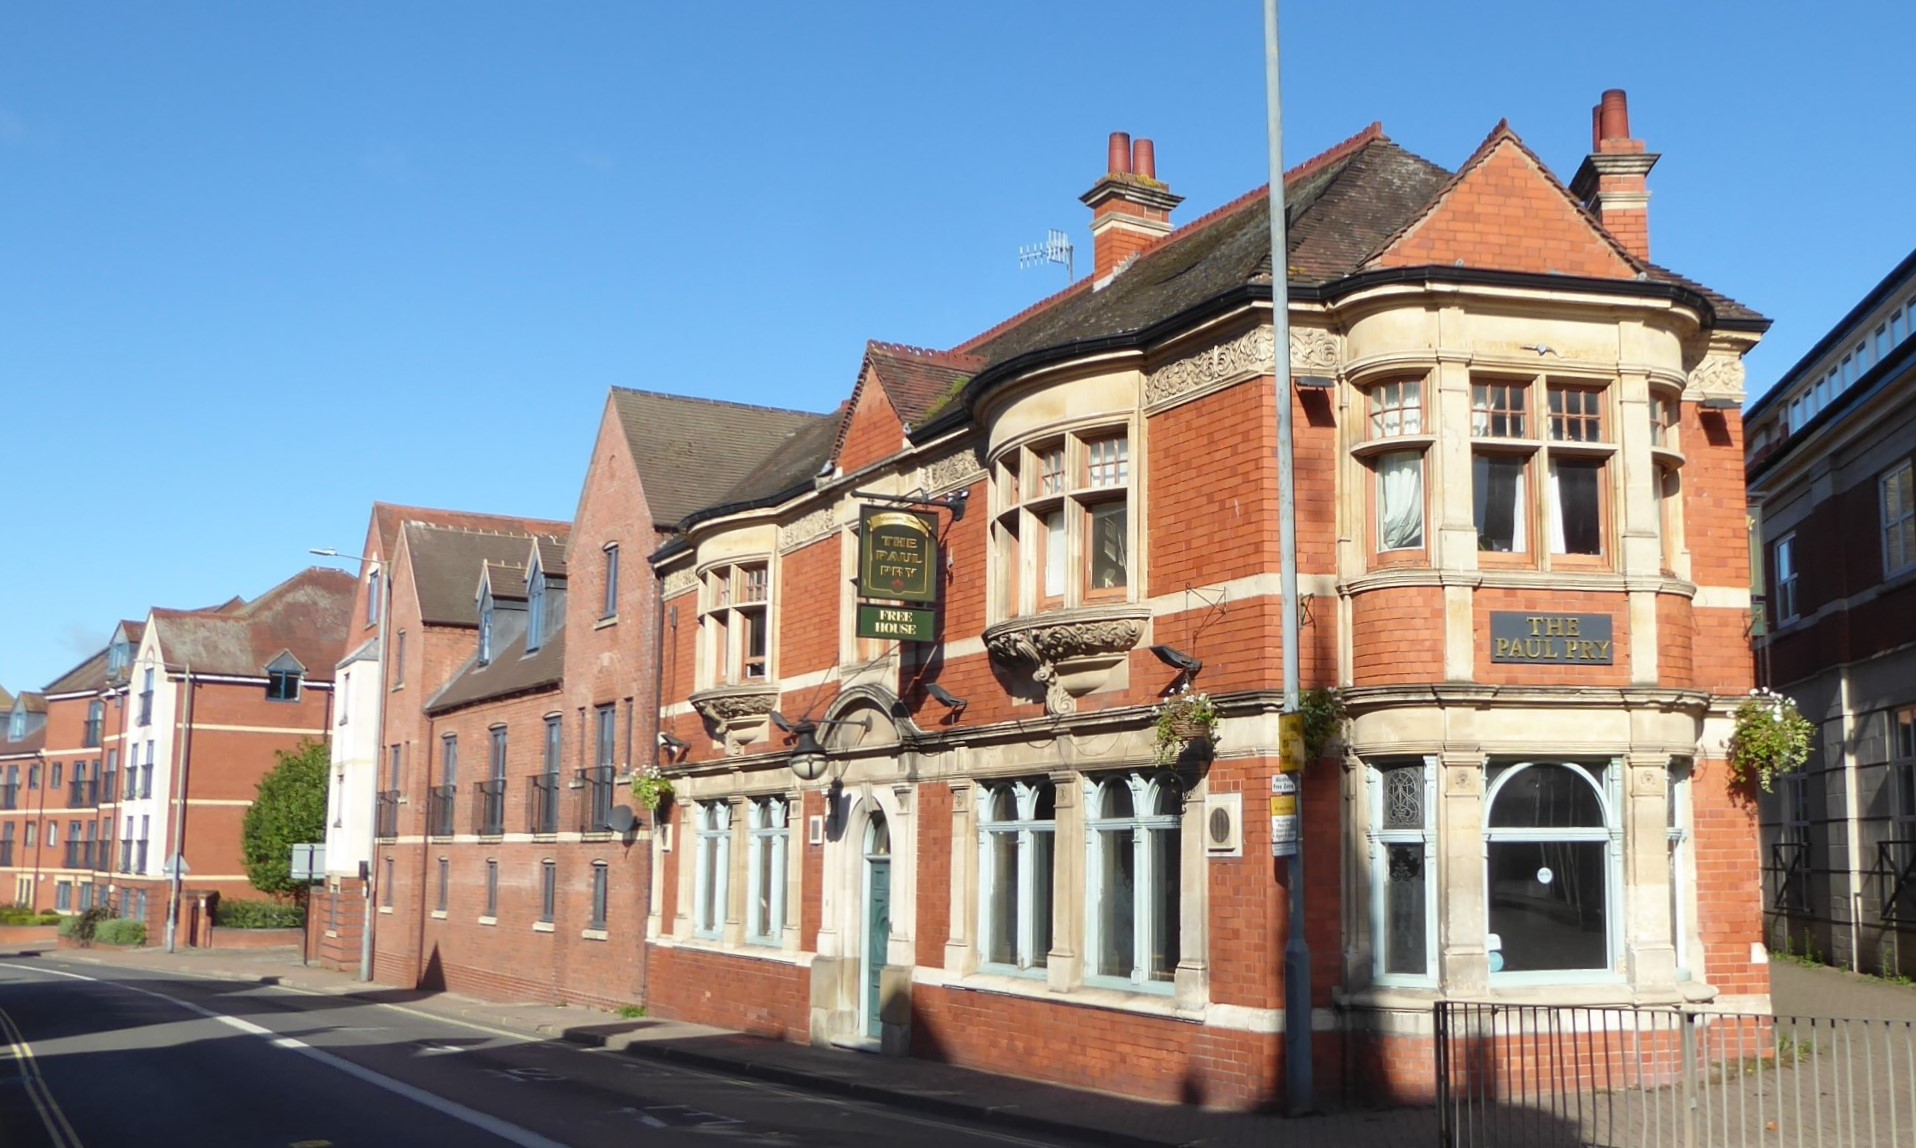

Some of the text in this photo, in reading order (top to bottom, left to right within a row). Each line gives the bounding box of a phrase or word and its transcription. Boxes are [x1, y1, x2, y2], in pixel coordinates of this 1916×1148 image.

[881, 535, 918, 549] THE
[875, 549, 923, 564] PAUL
[880, 565, 917, 578] PRY
[880, 610, 913, 622] FREE
[875, 622, 917, 634] HOUSE
[1526, 616, 1580, 637] THE
[1495, 638, 1611, 660] PAUL PRY
